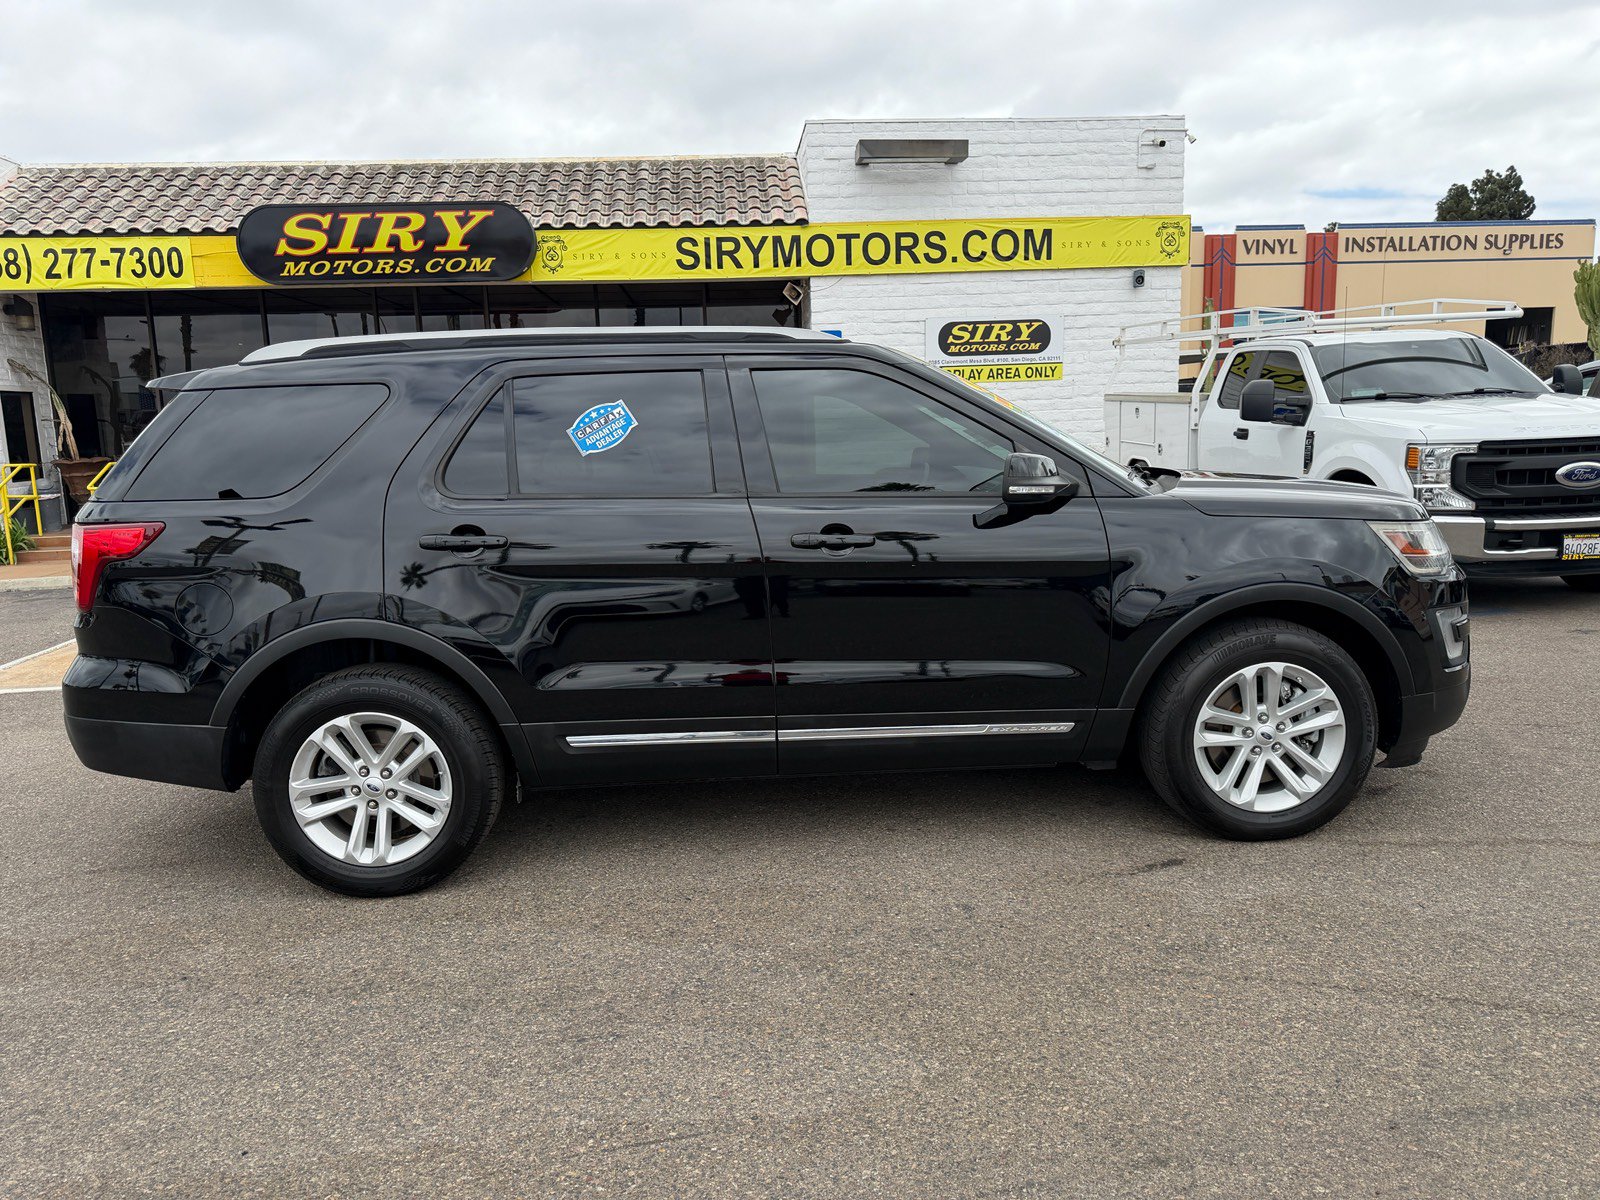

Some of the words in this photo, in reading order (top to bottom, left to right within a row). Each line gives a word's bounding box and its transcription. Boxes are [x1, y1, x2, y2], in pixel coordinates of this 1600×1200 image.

[274, 209, 495, 257] SIRY
[1344, 234, 1478, 253] INSTALLATION
[1484, 233, 1564, 251] SUPPLIES
[675, 227, 1053, 270] SIRYMOTORS.COM
[1117, 240, 1151, 248] SONS
[1243, 238, 1298, 255] VINYL
[0, 244, 32, 284] 8)
[43, 246, 184, 280] 277-7300
[280, 257, 496, 277] MOTORS.COM
[947, 321, 1043, 344] SIRY
[948, 342, 1042, 353] MOTORS.COM
[987, 367, 1021, 380] AREA
[1025, 366, 1058, 379] ONLY
[577, 410, 623, 438] CARFAX
[585, 418, 626, 446] ADVANTAGE
[596, 428, 624, 449] DEALER
[1571, 468, 1599, 480] Ford
[350, 686, 434, 713] CROSSOVER
